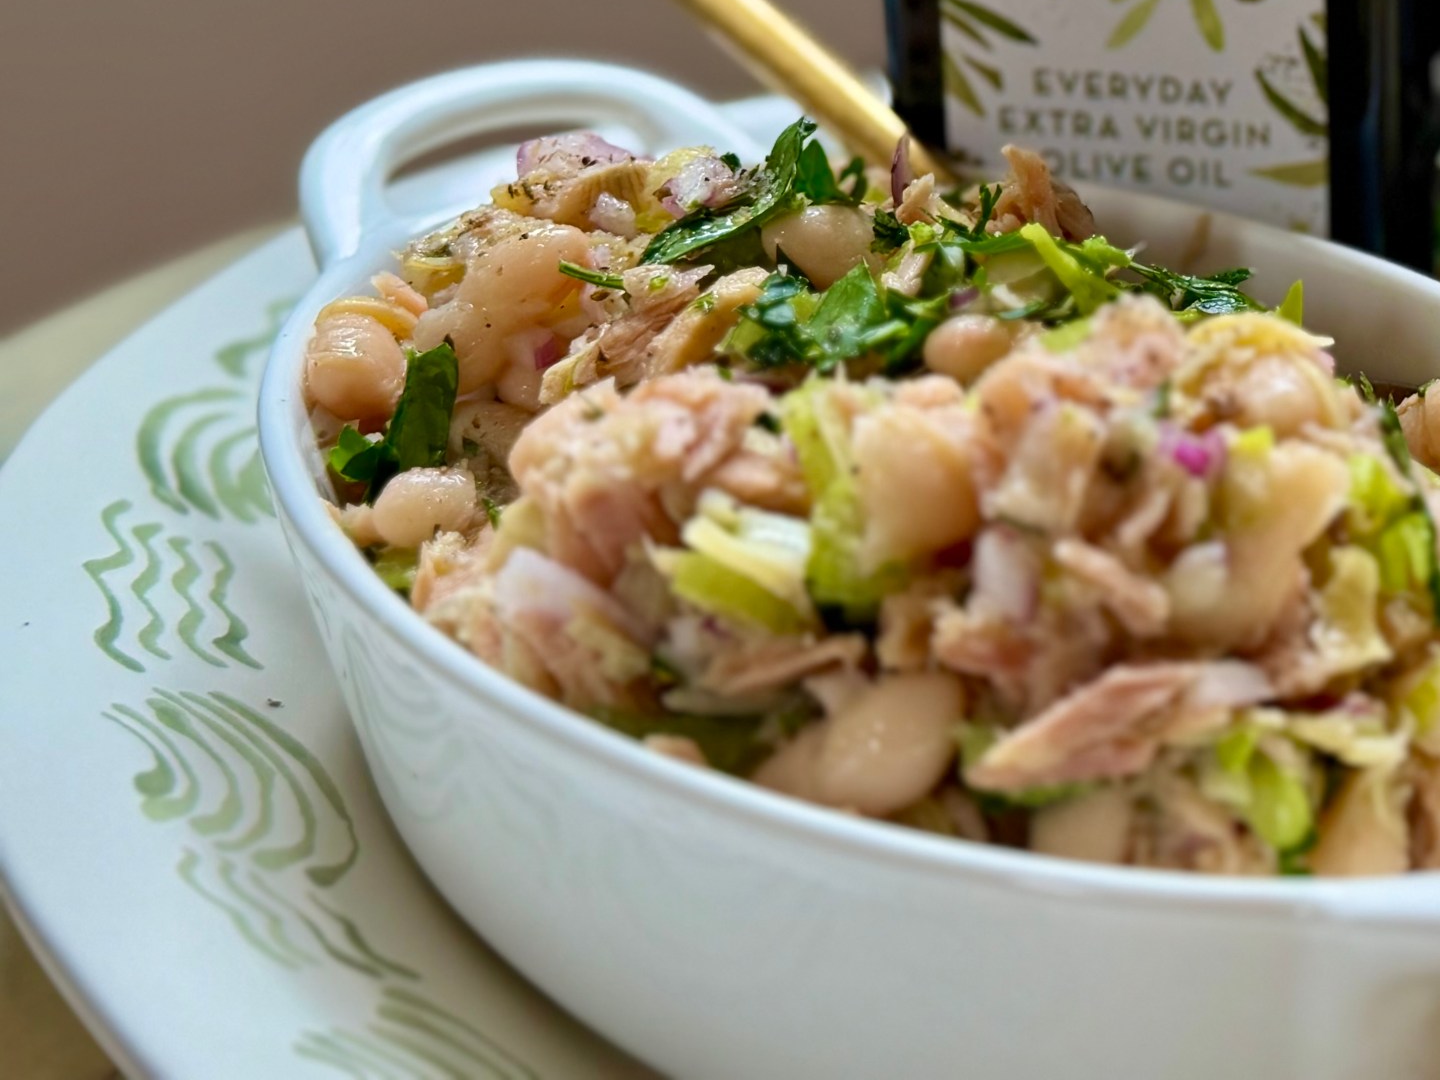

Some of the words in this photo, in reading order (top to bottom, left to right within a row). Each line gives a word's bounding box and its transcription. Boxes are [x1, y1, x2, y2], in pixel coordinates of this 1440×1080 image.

[1032, 68, 1233, 106] EVERYDAY
[998, 104, 1122, 140] EXTRA
[1136, 113, 1271, 148] VIRGIN
[1166, 154, 1233, 189] OIL
